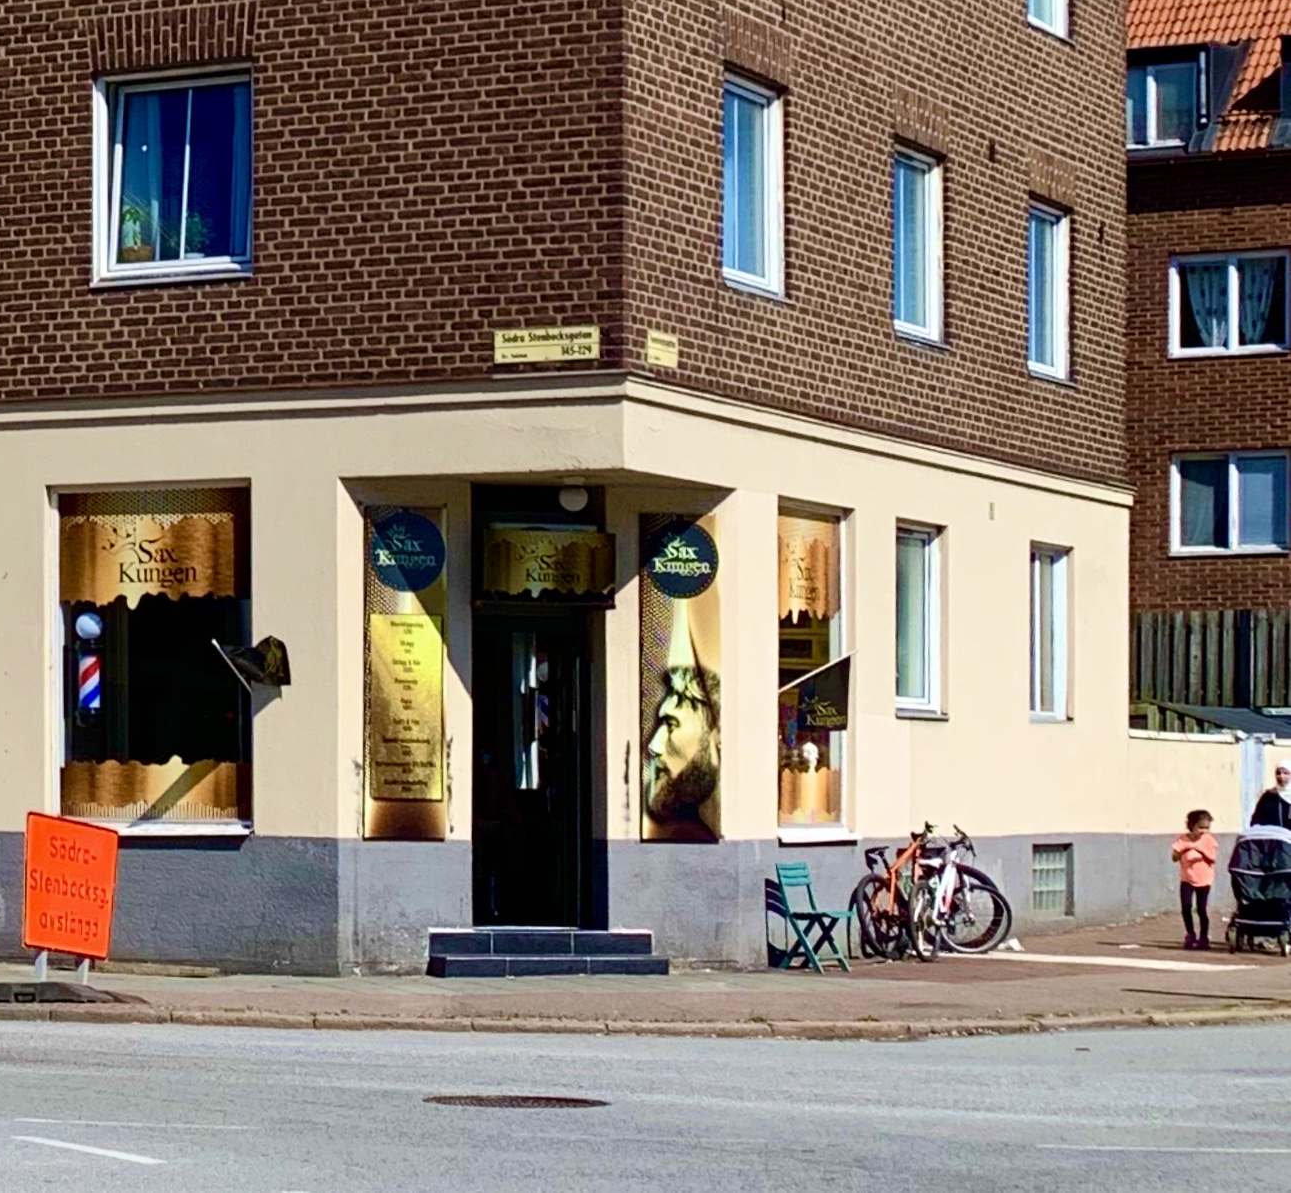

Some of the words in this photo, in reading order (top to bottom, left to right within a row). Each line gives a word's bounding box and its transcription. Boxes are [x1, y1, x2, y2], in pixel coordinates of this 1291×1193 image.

[502, 333, 525, 343] Södra
[528, 329, 592, 342] Stenbocksgatan
[137, 535, 178, 564] Sax
[390, 534, 423, 552] Sax
[665, 540, 698, 559] Sax
[375, 548, 436, 569] Kungen
[652, 557, 711, 577] Kungen
[796, 556, 819, 582] Sax
[119, 562, 197, 588] Kungen
[526, 569, 580, 584] Kungen
[788, 577, 820, 606] Kungen
[806, 714, 846, 727] Kungen
[30, 867, 109, 909] Stenbocksg.
[39, 910, 99, 943] avstängd
